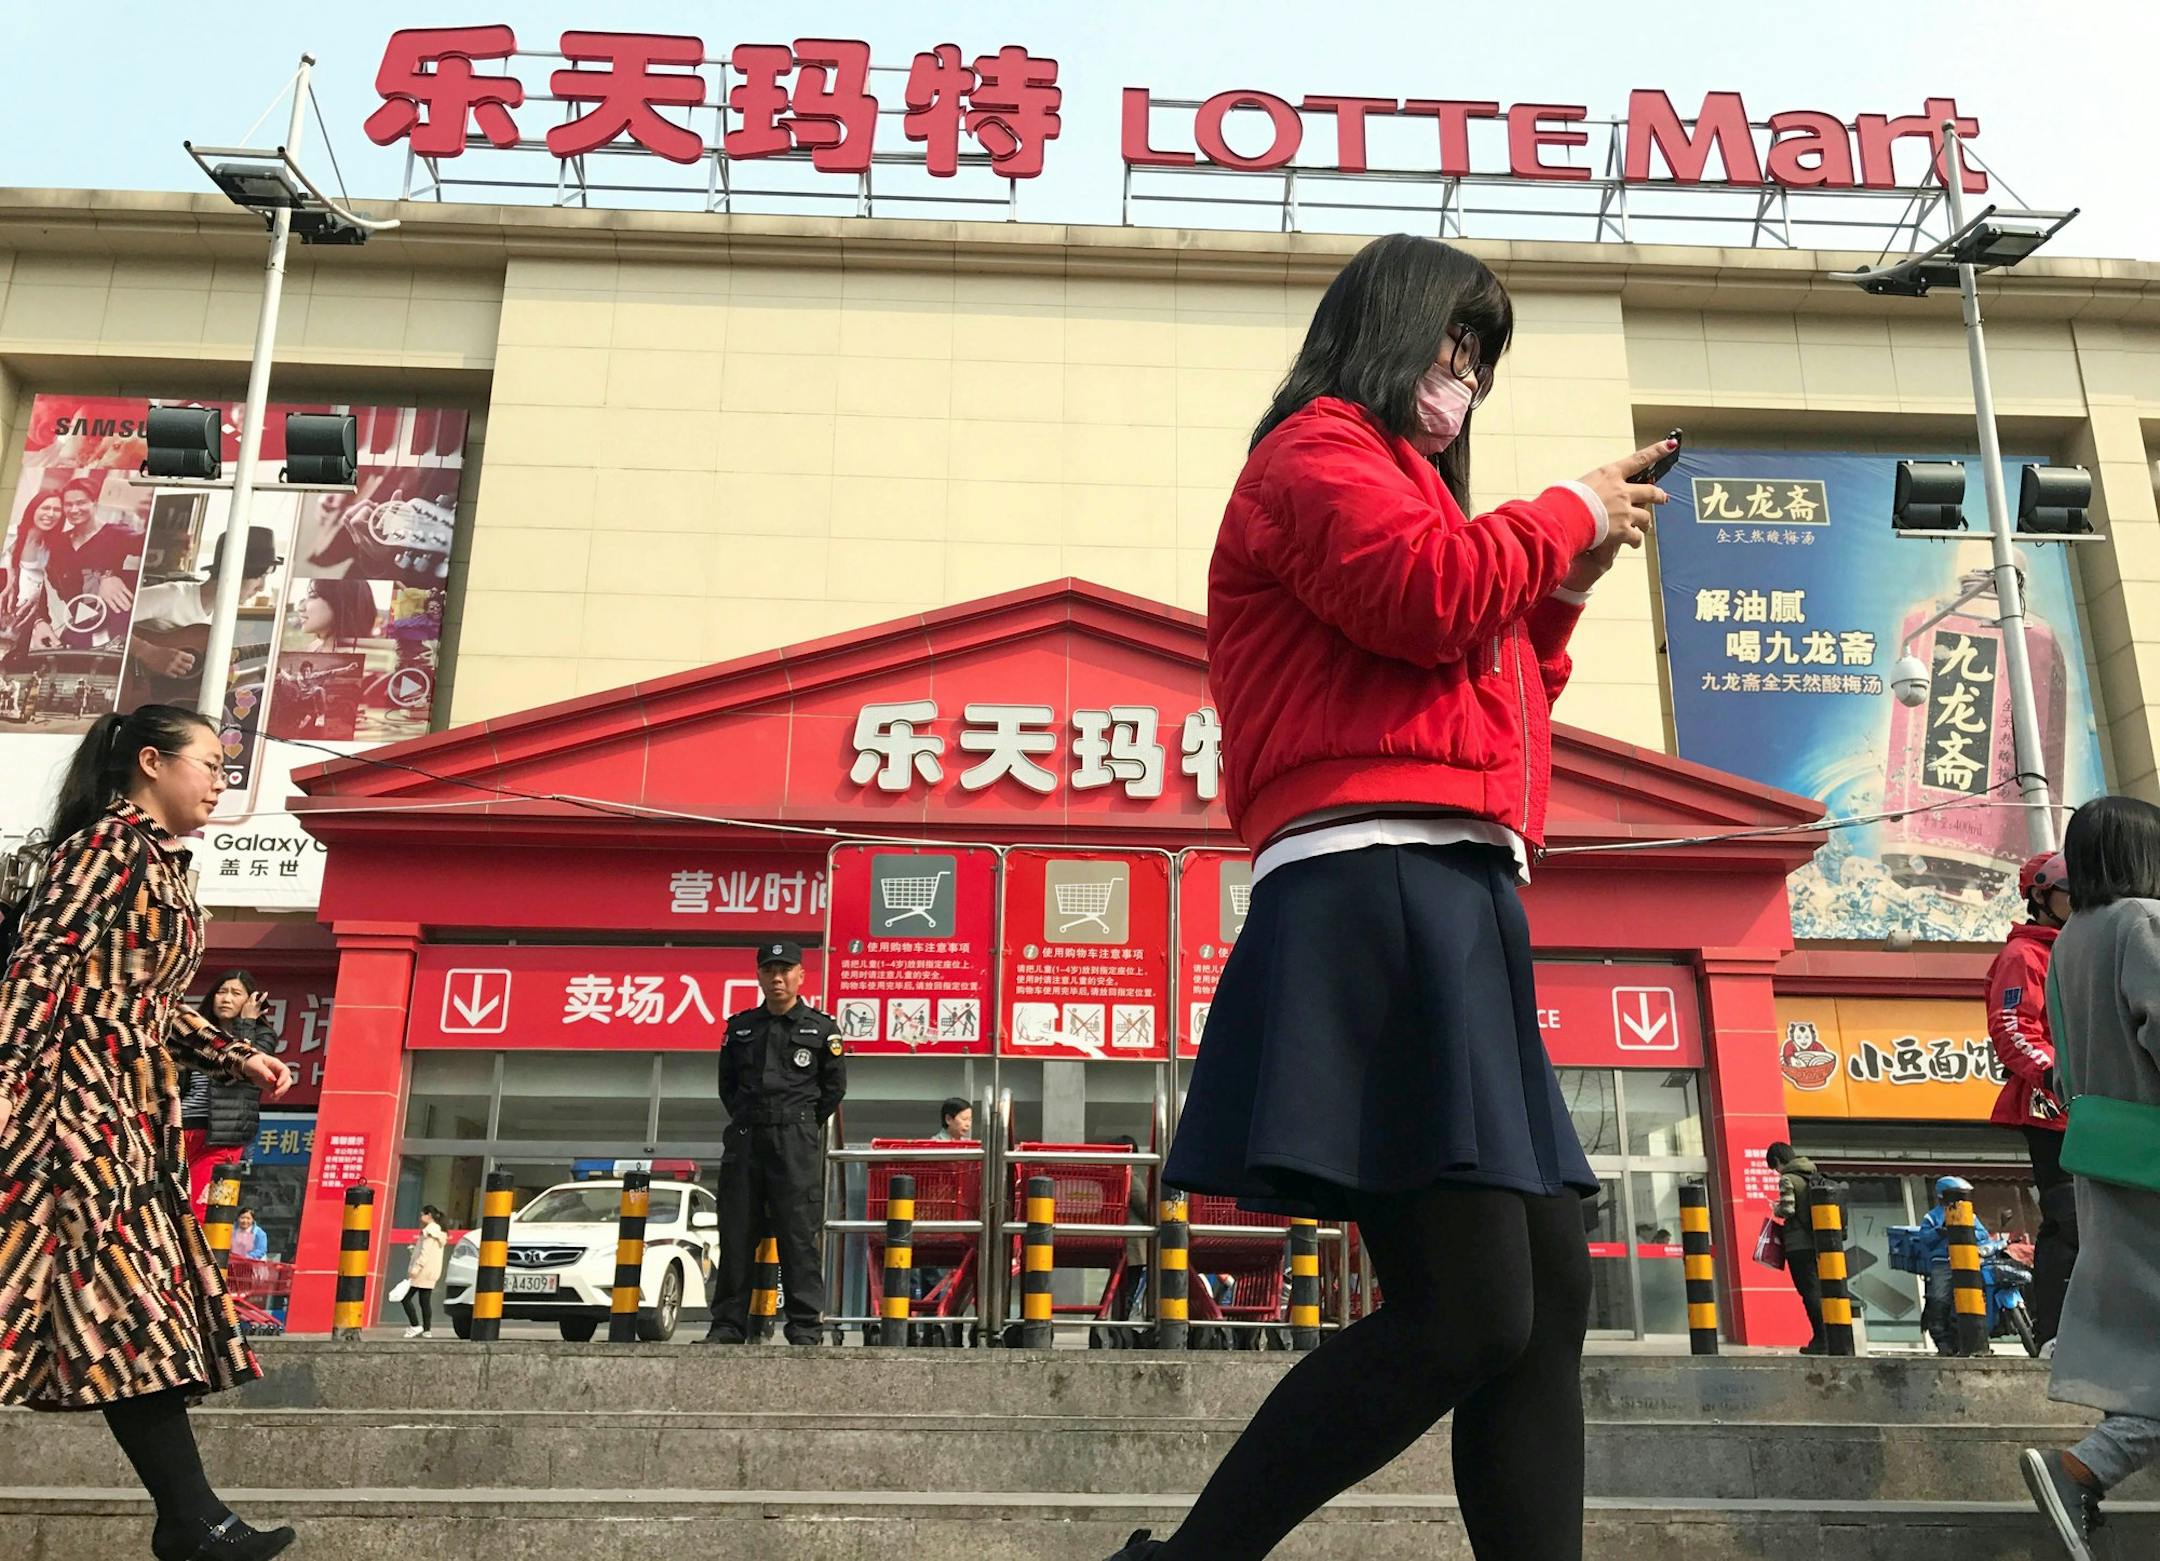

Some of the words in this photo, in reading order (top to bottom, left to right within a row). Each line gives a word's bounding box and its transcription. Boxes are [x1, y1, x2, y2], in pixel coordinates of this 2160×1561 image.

[363, 24, 1063, 179] 乐天玛特
[1121, 86, 1593, 181] LOTTE
[1622, 88, 1989, 195] Mart
[1702, 482, 1820, 522] 九龙斋
[1715, 528, 1816, 546] 全天然酸梅汤
[1694, 588, 1806, 624] 解油腻
[1726, 630, 1876, 666] 喝九龙斋
[1701, 672, 1883, 695] 九龙斋全天然酸梅汤
[1926, 634, 1994, 791] 九龙斋
[214, 833, 308, 857] Galaxy
[219, 858, 299, 877] 盖乐世
[867, 942, 970, 954] 使用购物车注意事项
[1042, 947, 1144, 960] 使用购物车注意事项
